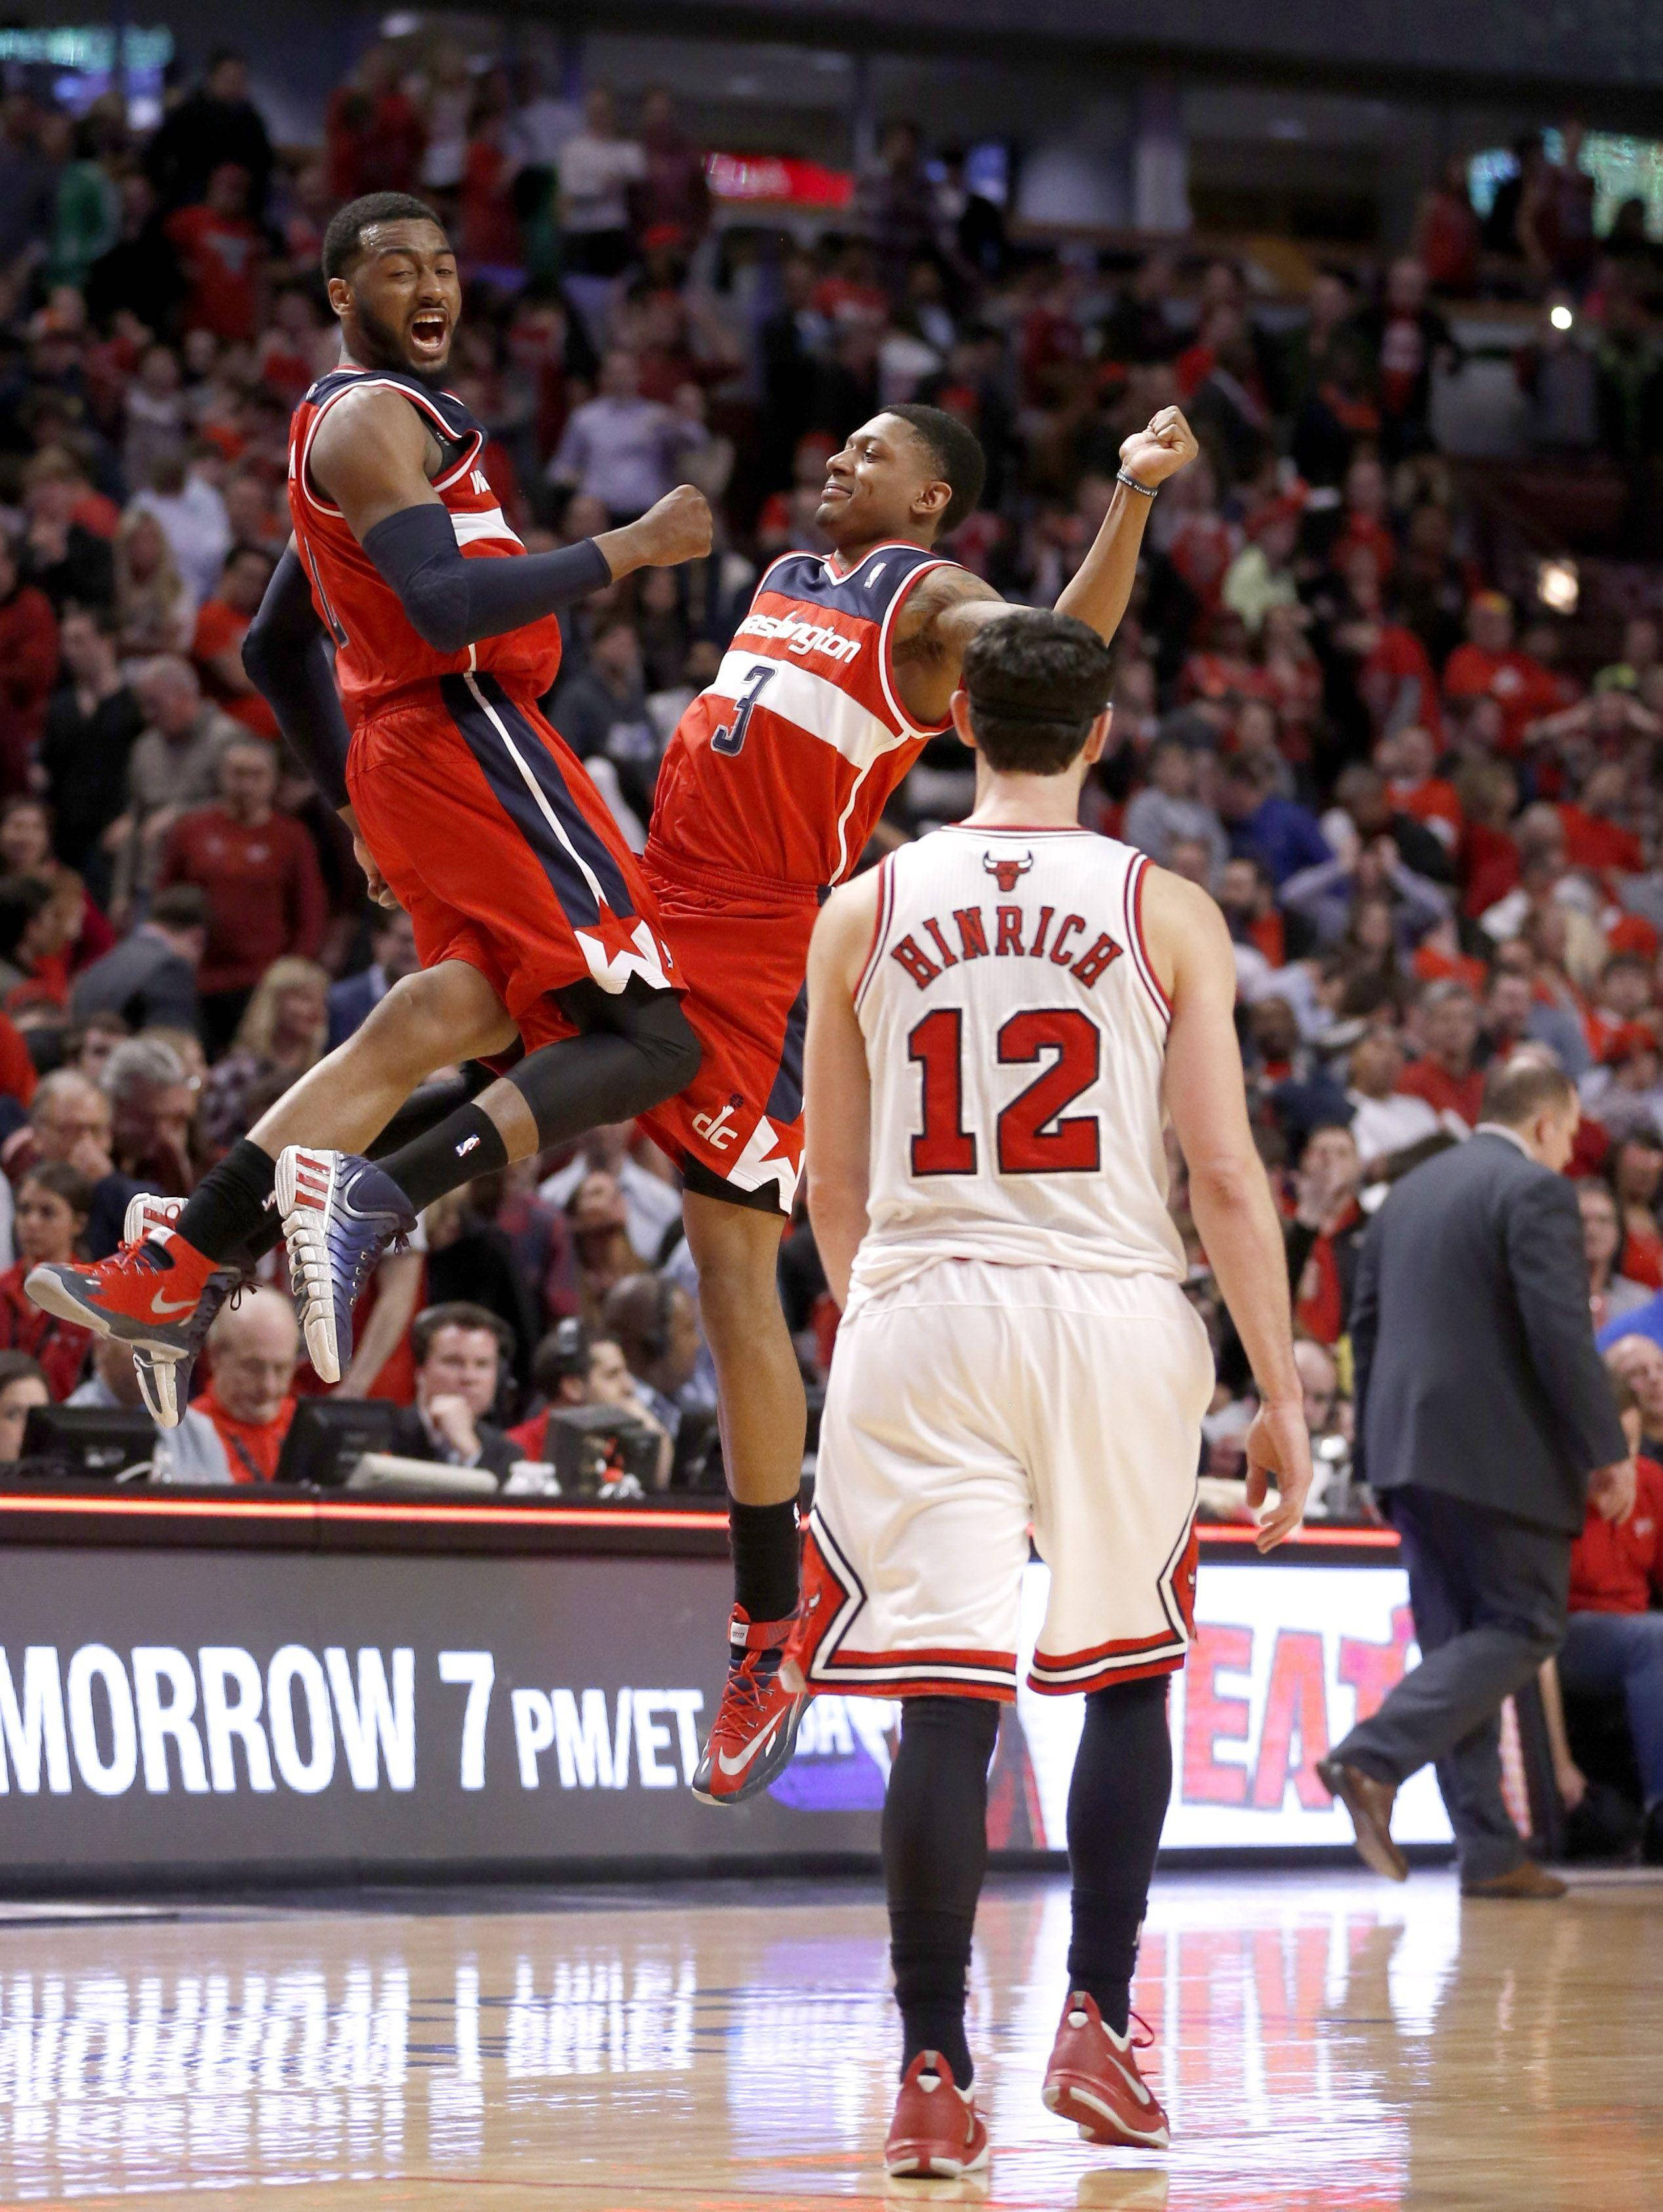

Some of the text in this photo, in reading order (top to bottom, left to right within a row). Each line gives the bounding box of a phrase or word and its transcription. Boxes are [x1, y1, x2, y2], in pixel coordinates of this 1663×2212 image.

[710, 664, 776, 757] 3
[891, 905, 1124, 991] HINRICH
[908, 1008, 1101, 1177] 12
[0, 1643, 705, 1797] MORROW 7 PM/ET
[1169, 1606, 1416, 1813] EAT
